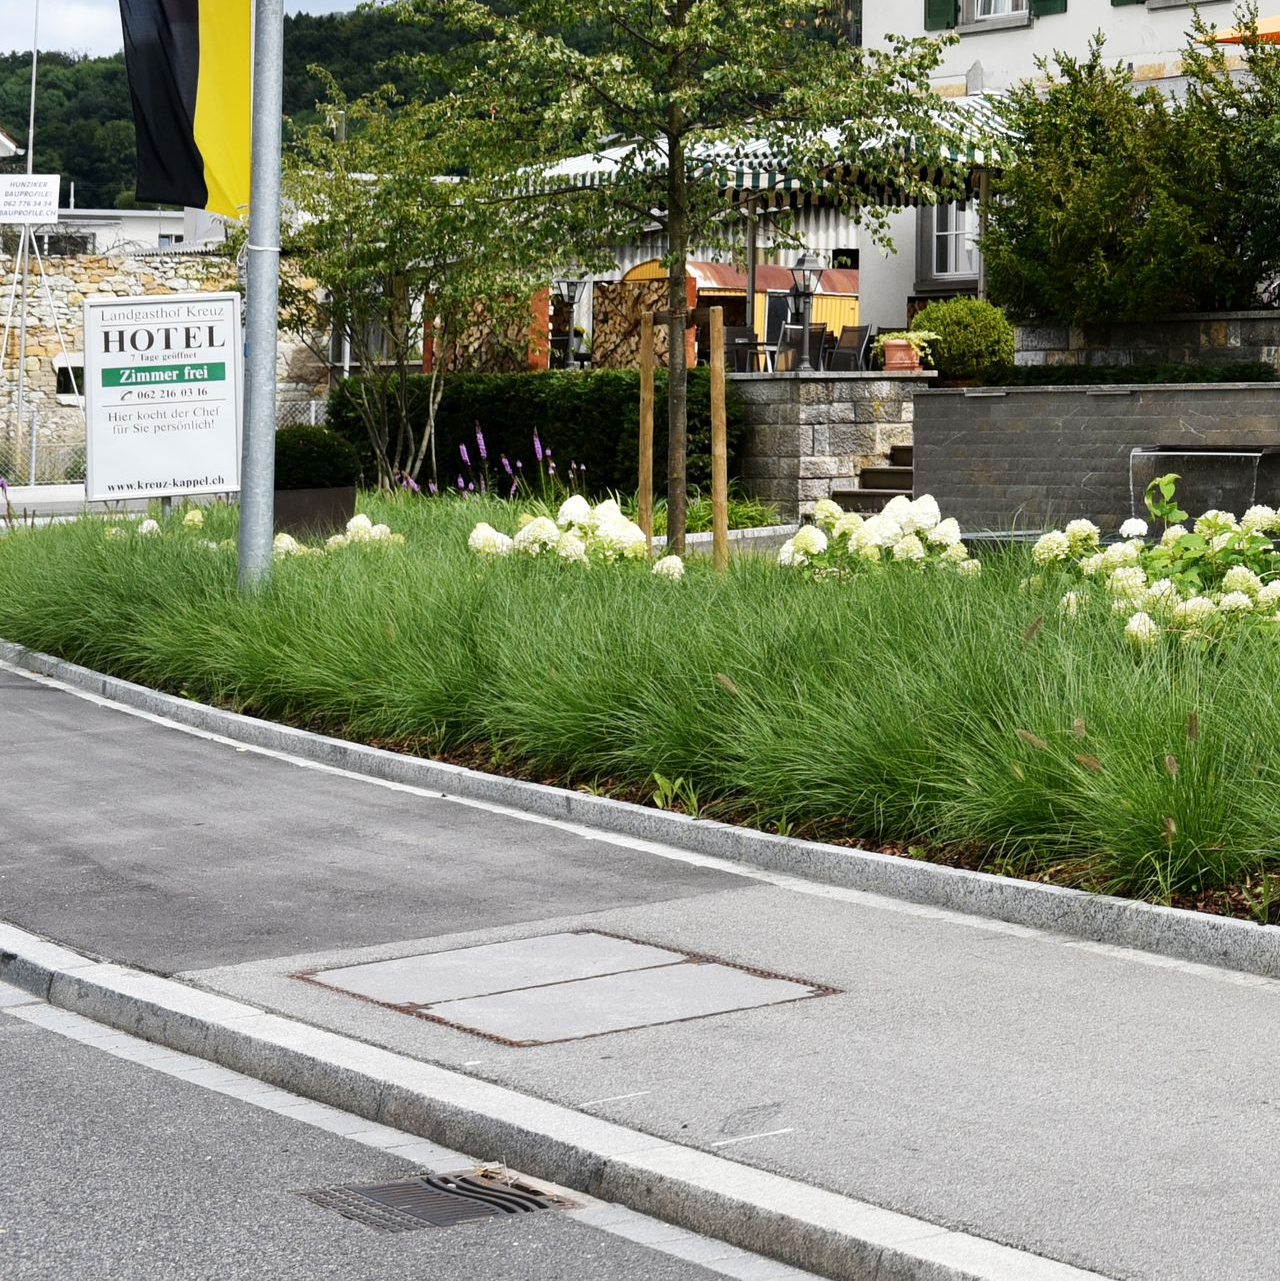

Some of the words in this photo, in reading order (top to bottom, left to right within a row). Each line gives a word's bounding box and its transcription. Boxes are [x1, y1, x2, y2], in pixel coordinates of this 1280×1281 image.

[101, 307, 182, 322] Landgasthof
[187, 305, 225, 318] Kreuz
[102, 325, 226, 353] HOTEL
[130, 353, 136, 362] 7
[140, 353, 159, 362] Tage
[162, 351, 197, 361] geöffnet
[120, 369, 179, 383] Zimmer
[184, 365, 208, 380] frei
[137, 390, 156, 399] 062
[160, 389, 177, 398] 216
[181, 388, 193, 397] 03
[197, 387, 208, 396] 16
[108, 411, 132, 422] Hier
[137, 409, 167, 421] kocht
[171, 408, 189, 418] der
[193, 406, 220, 417] Chef
[113, 423, 129, 435] für
[133, 422, 149, 433] Sie
[153, 419, 215, 434] persönlich!
[107, 475, 225, 492] www.kreuz-kappel.ch
